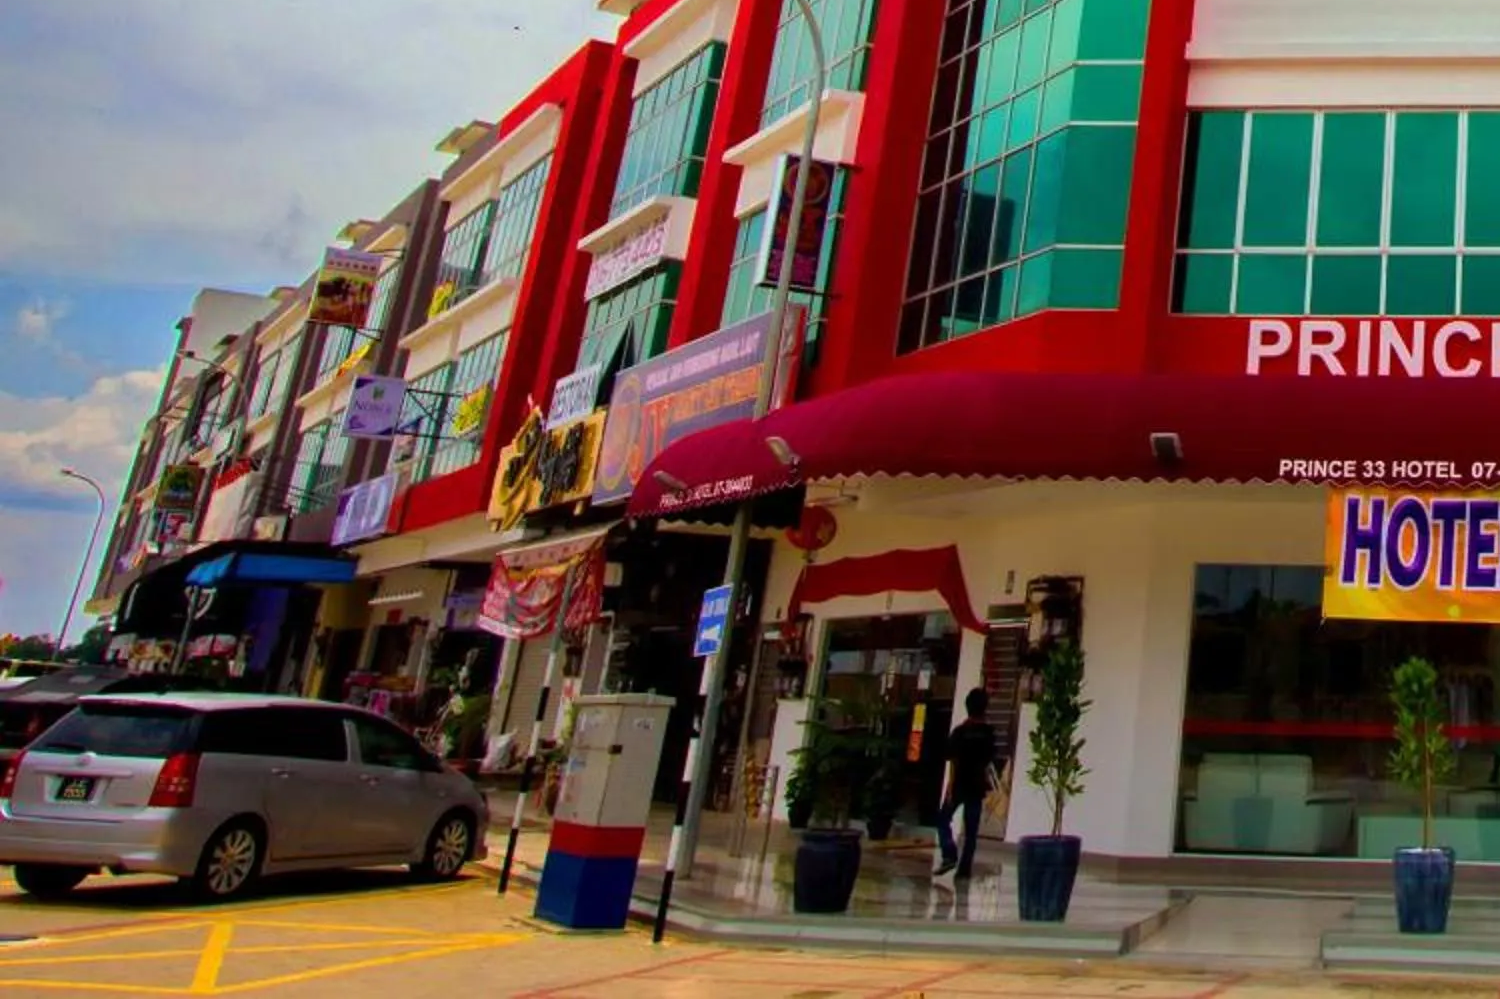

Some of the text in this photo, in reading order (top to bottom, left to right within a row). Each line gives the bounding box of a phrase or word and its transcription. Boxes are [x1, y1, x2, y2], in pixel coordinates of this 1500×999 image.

[1278, 458, 1357, 478] PRINCE
[1362, 460, 1385, 479] 33
[1391, 460, 1463, 479] HOTEL
